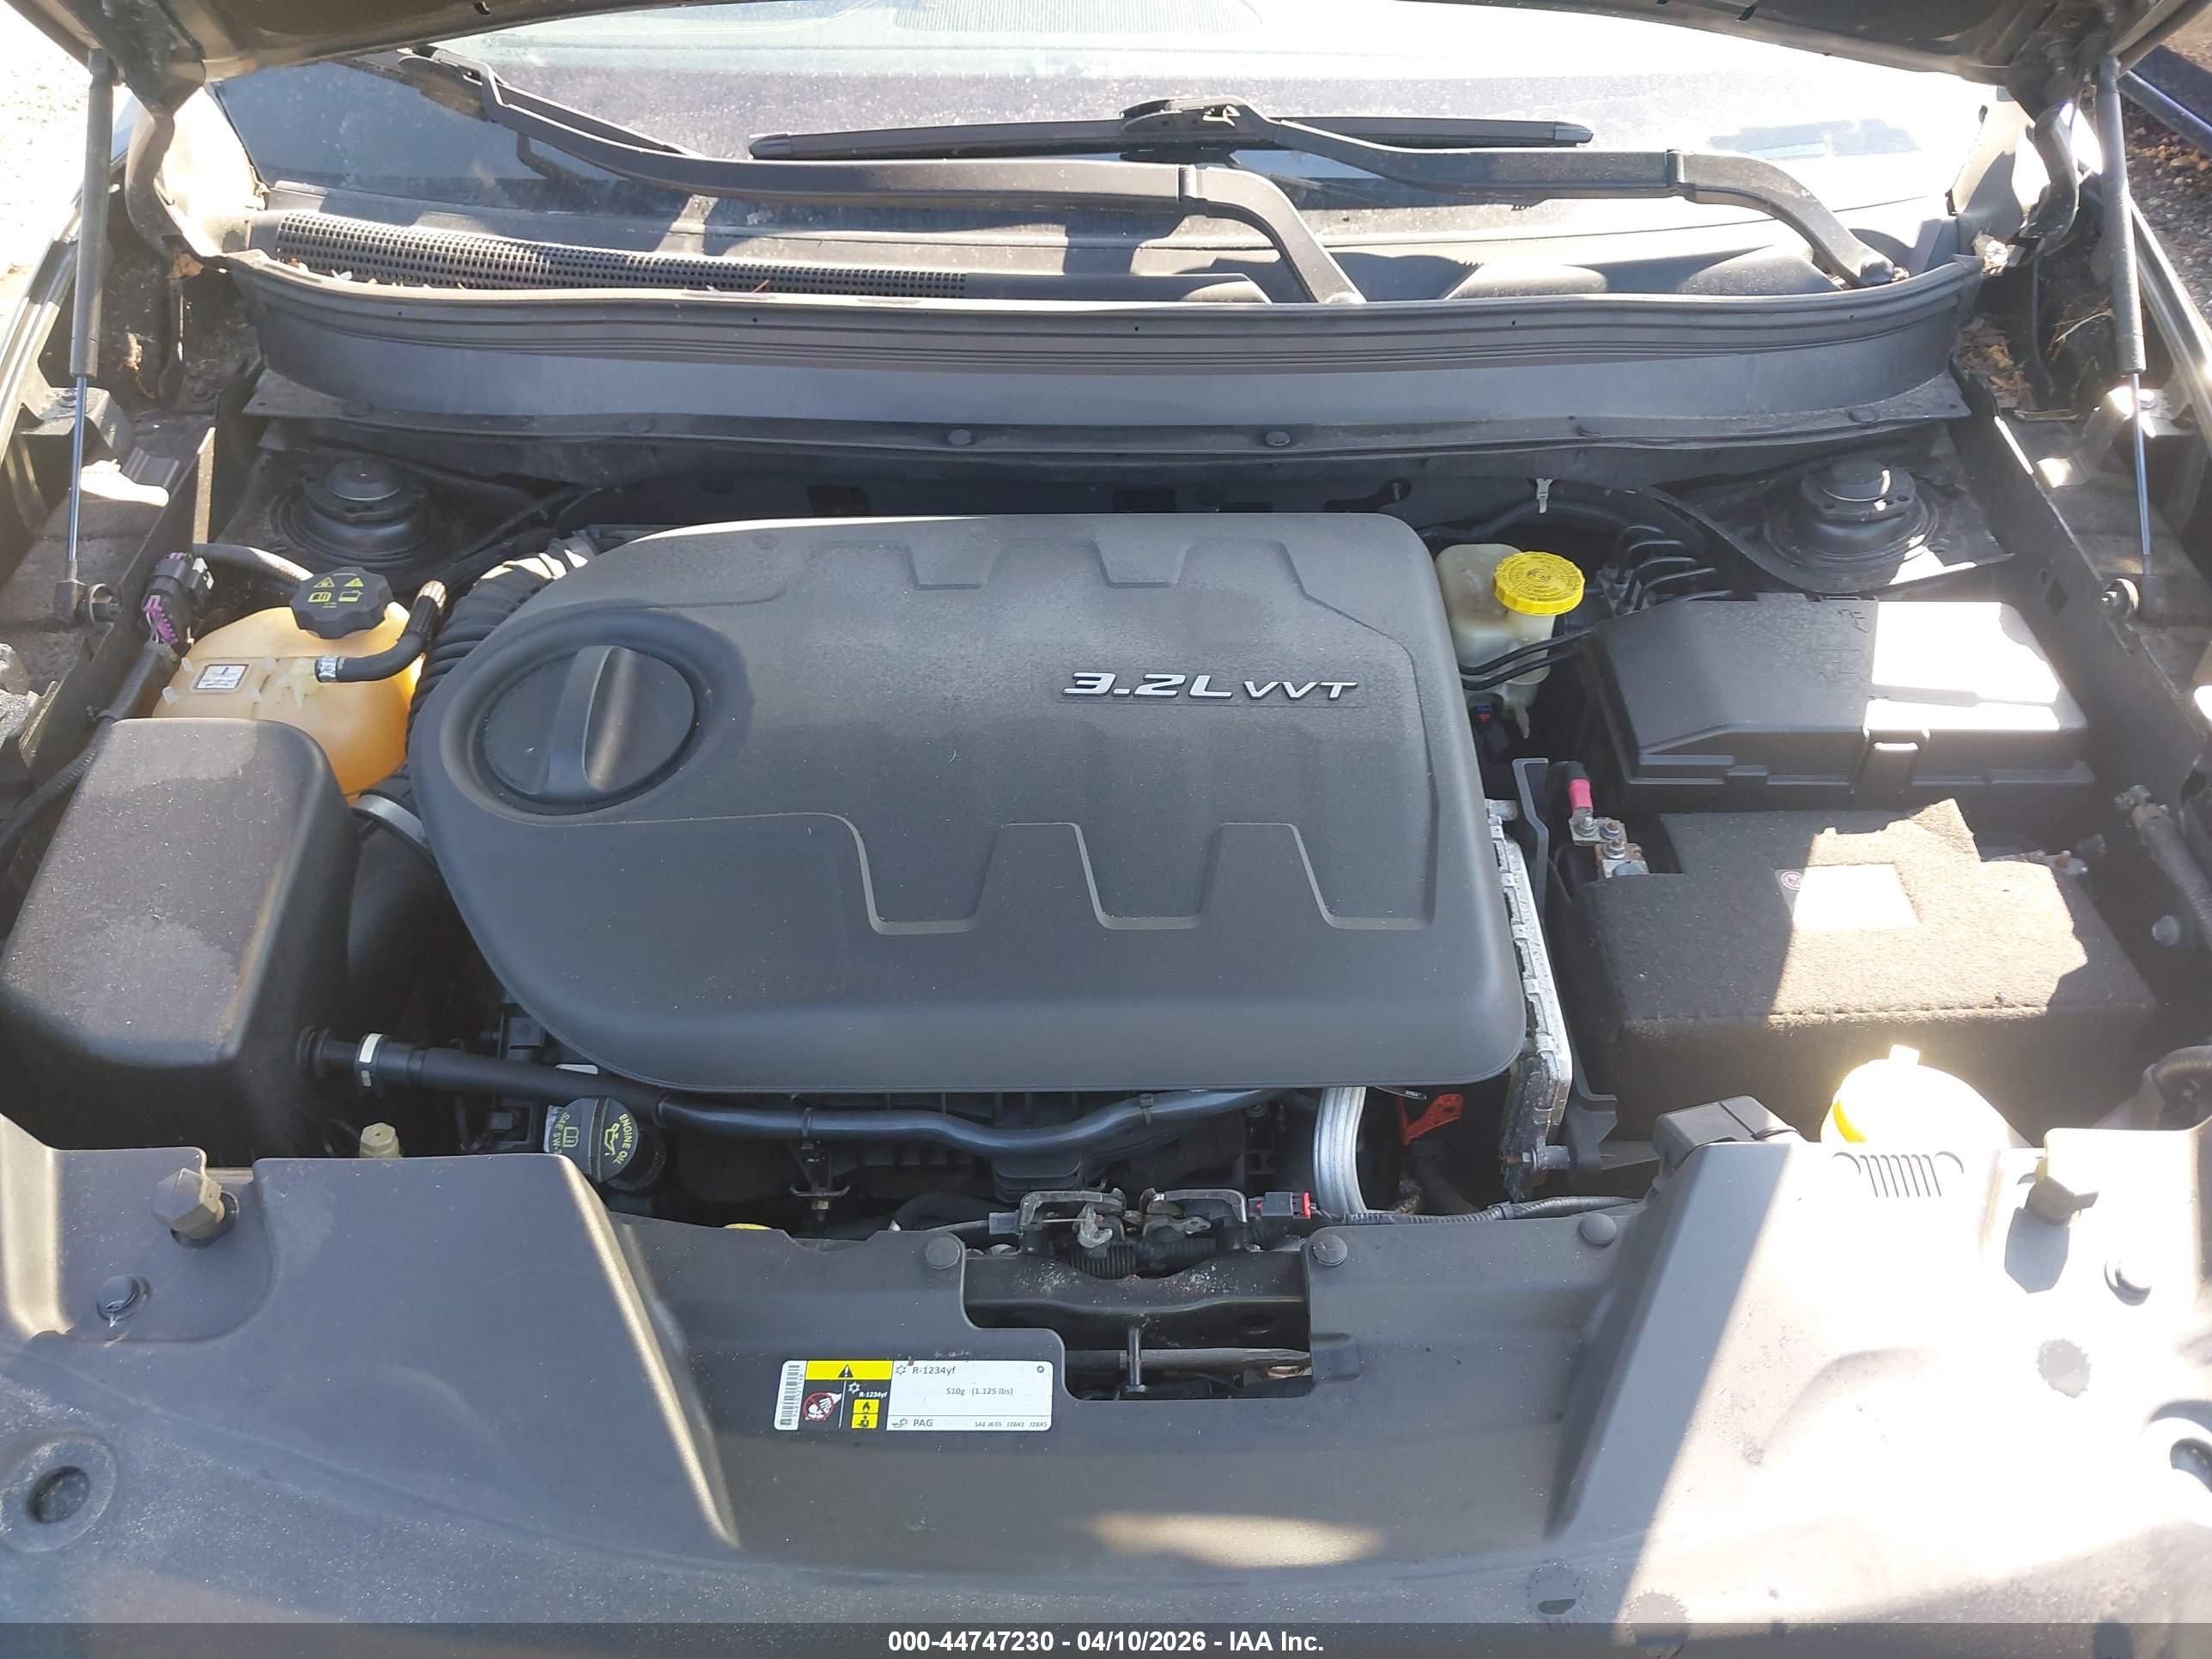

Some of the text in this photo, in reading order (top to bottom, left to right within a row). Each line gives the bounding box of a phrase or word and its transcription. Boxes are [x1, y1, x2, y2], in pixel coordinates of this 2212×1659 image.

[1063, 672, 1359, 702] 3.2L VVT
[556, 1112, 570, 1131] SAE
[611, 1113, 633, 1165] ENGINE OIL
[912, 1365, 957, 1376] R-1234yf
[946, 1387, 1014, 1396] 510g (1.125 lbs)
[913, 1419, 933, 1427] PAG
